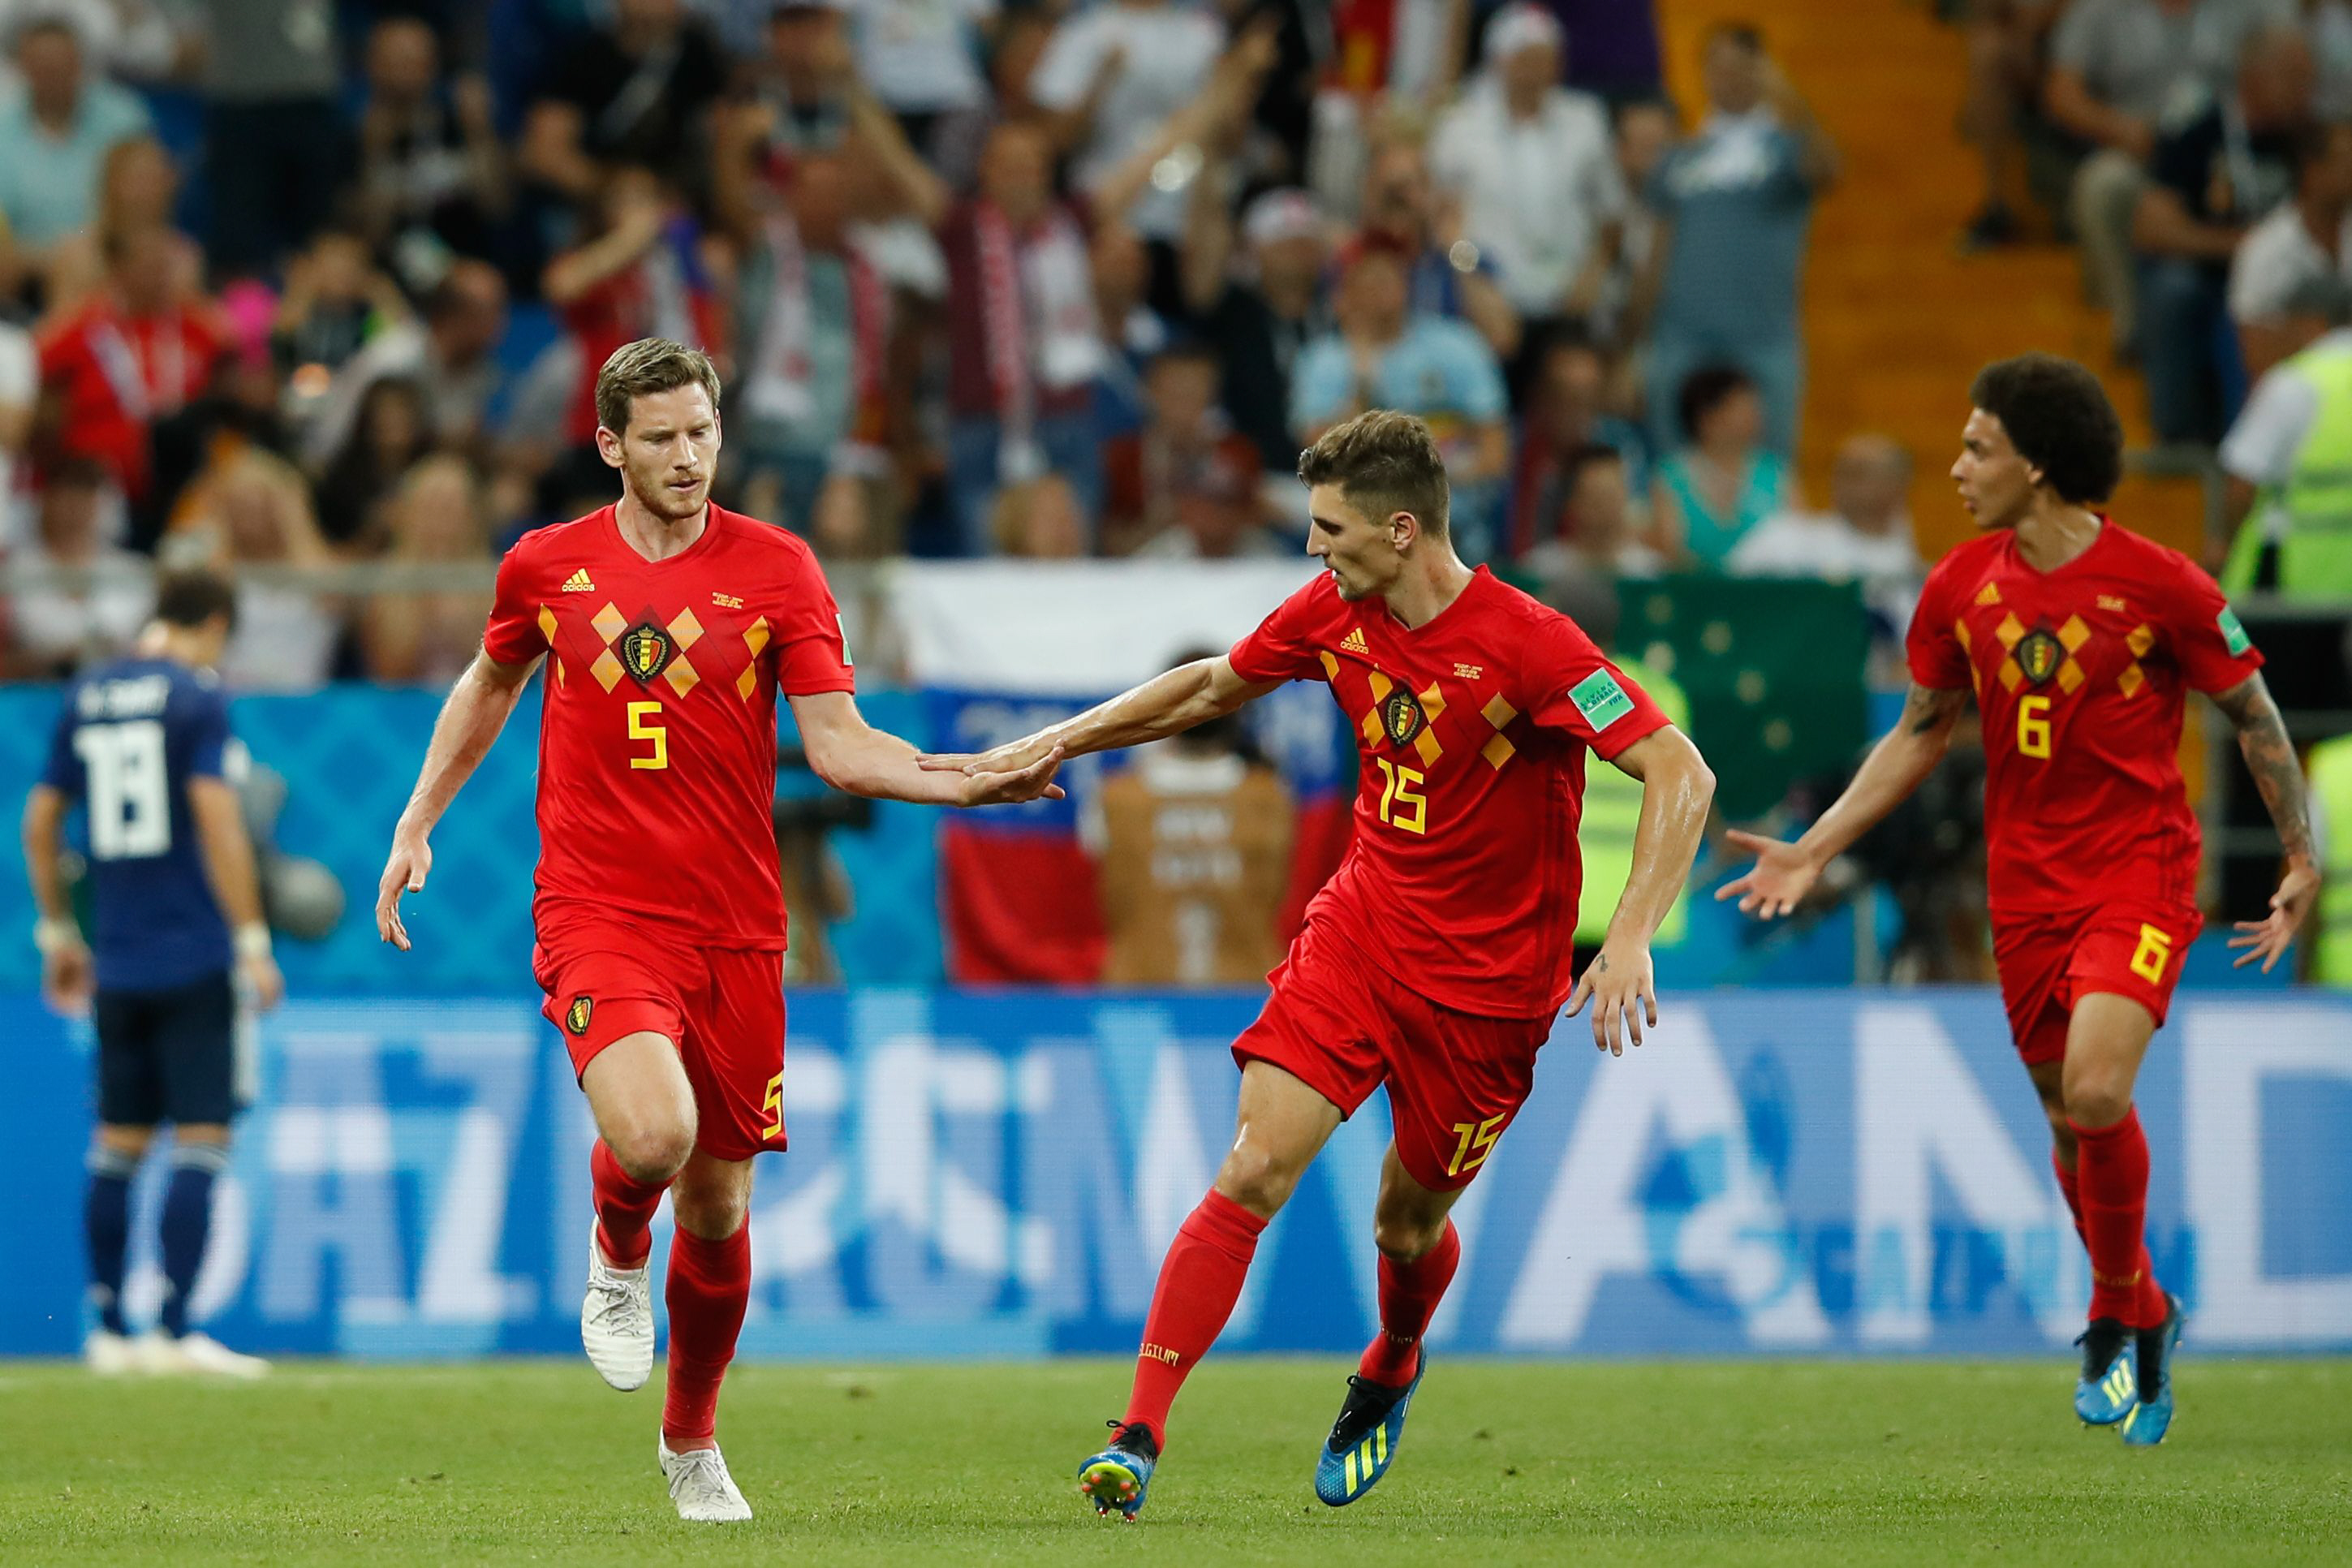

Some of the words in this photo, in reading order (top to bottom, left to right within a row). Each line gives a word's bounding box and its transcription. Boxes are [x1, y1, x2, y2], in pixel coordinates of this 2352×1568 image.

[562, 583, 595, 592] adidas
[1340, 641, 1369, 655] adidas
[1609, 694, 1623, 706] FIFA
[2017, 696, 2051, 759] 6
[627, 701, 667, 769] 5
[1377, 757, 1427, 834] 15
[2130, 924, 2171, 984] 6
[761, 1071, 784, 1139] 5
[1448, 1114, 1505, 1176] 15
